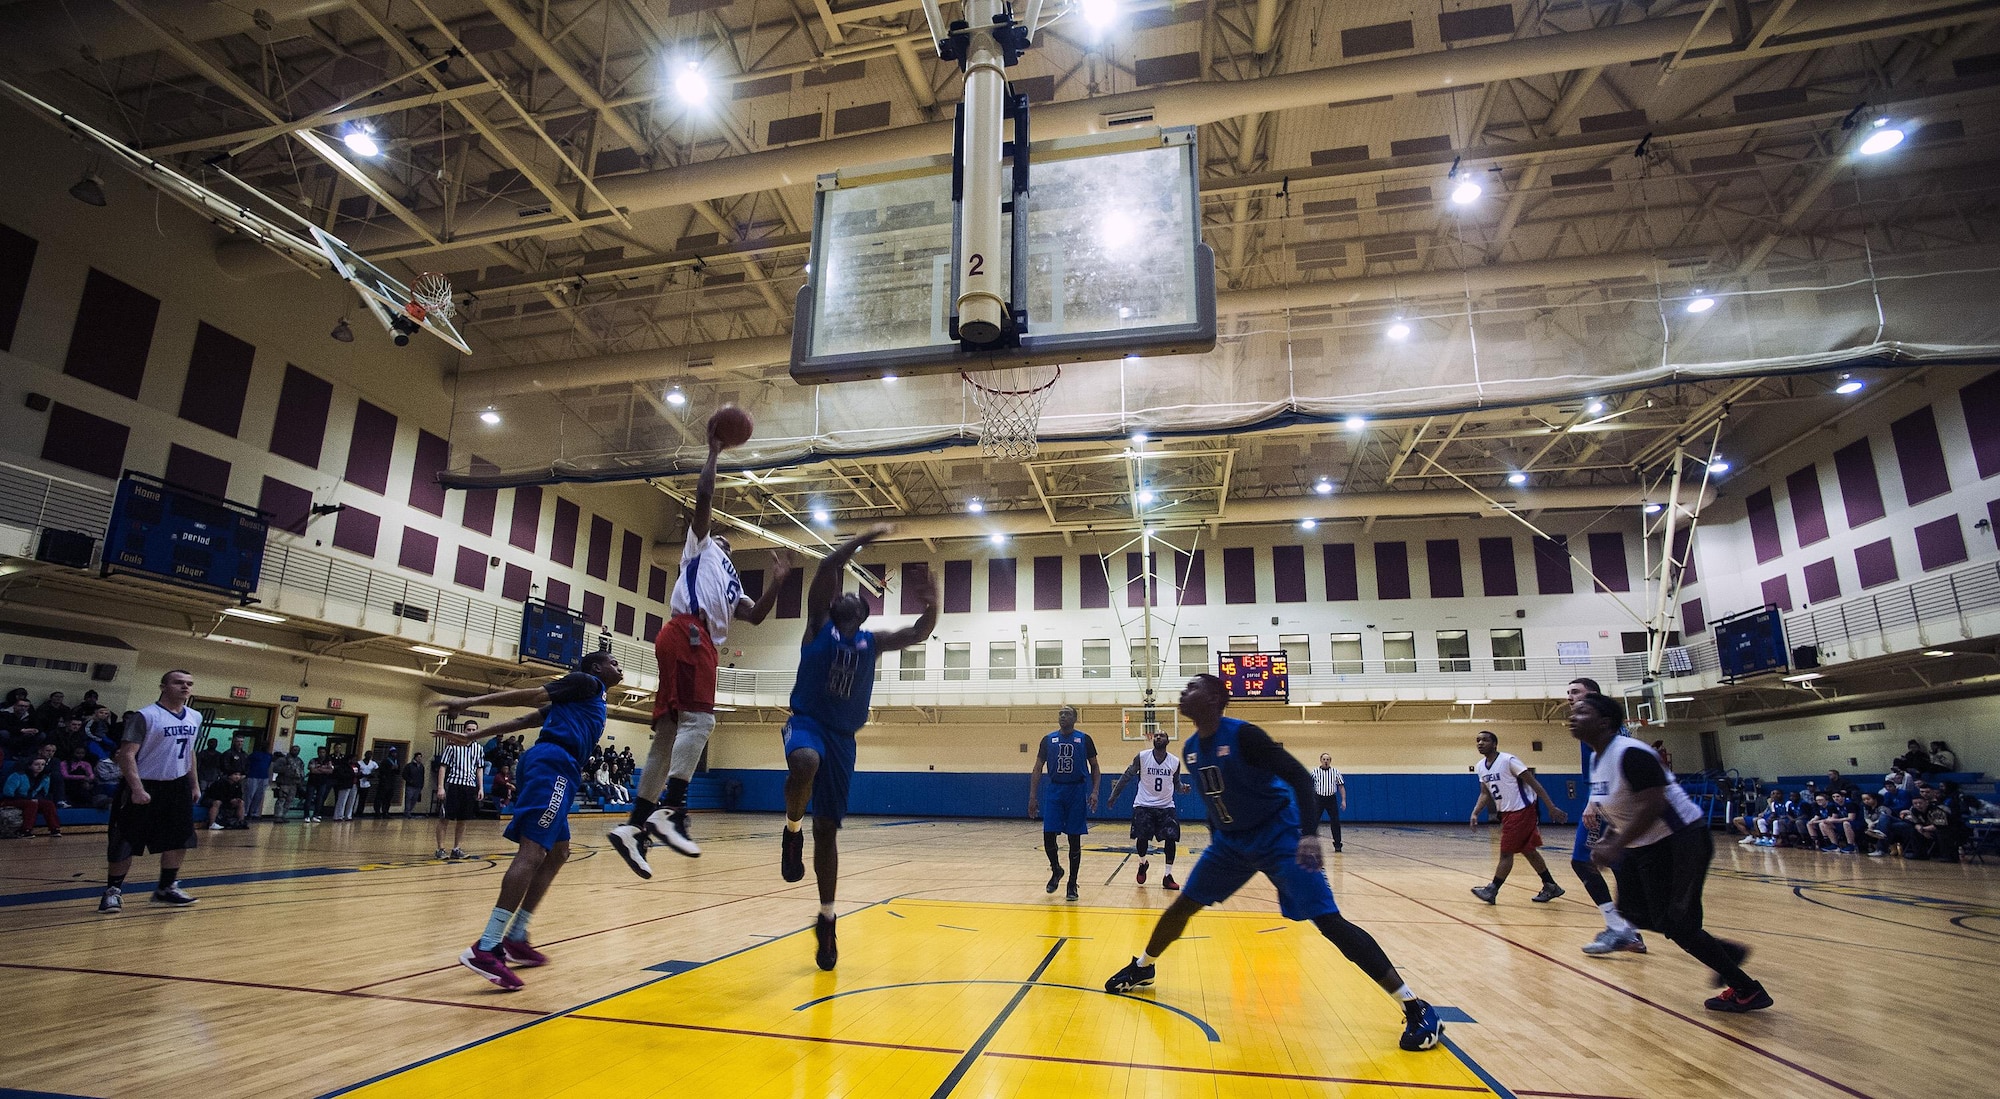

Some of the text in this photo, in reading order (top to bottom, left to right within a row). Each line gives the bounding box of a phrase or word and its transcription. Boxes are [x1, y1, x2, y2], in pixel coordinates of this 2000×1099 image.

[969, 253, 984, 277] 2
[134, 485, 161, 502] Home
[182, 532, 211, 546] period
[119, 551, 143, 565] fouls
[176, 564, 204, 577] player
[232, 577, 251, 589] fouls
[1242, 655, 1268, 668] 16:32
[1272, 662, 1288, 675] 25
[1221, 663, 1236, 675] 45
[1262, 670, 1269, 680] 2
[1225, 680, 1232, 690] 2
[176, 738, 188, 759] 7
[1057, 758, 1074, 773] 13
[1147, 768, 1171, 777] KUNSAN
[1154, 777, 1163, 792] 8
[1491, 784, 1502, 800] 2
[537, 775, 568, 829] DEFENDERS
